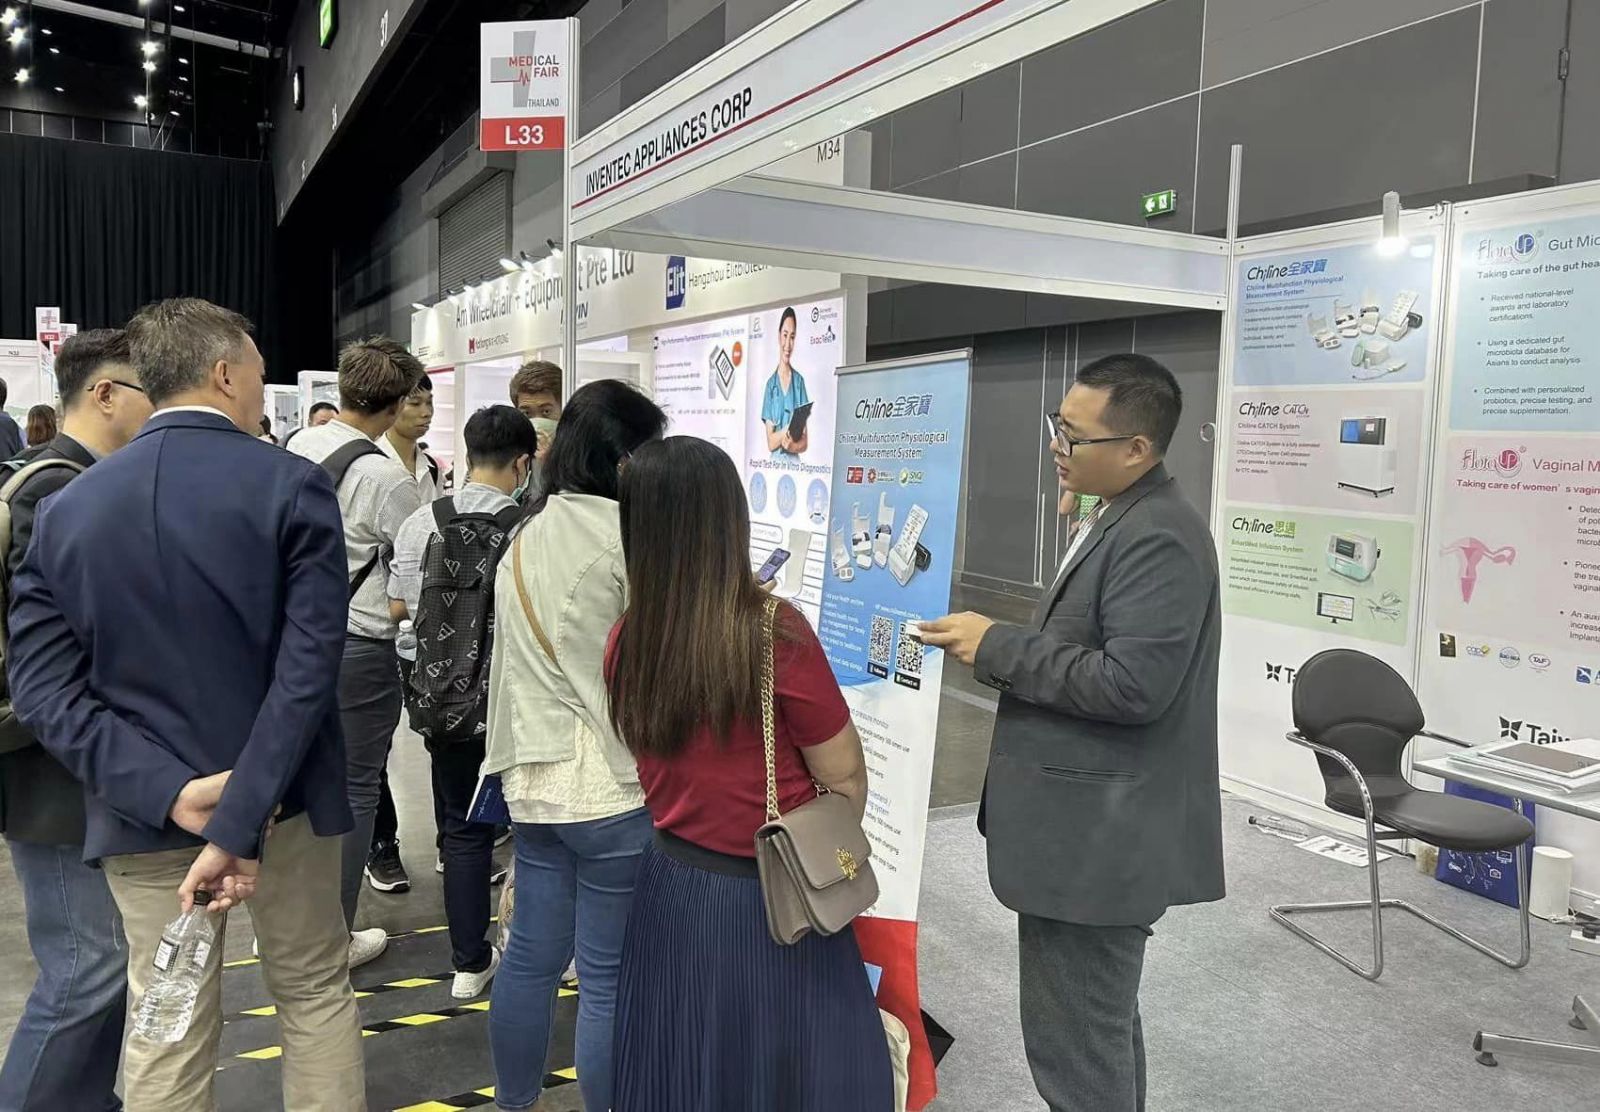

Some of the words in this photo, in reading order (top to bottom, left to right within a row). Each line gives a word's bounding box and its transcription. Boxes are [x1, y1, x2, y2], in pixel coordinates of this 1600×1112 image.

[508, 54, 560, 68] MEDICAL
[533, 66, 560, 78] FAIR
[528, 98, 560, 109] THAILAND
[505, 124, 544, 145] L33
[586, 152, 631, 197] INVENTEC
[633, 111, 707, 173] APPLIANCES
[710, 87, 752, 134] CORP
[817, 137, 841, 163] M34
[1548, 237, 1573, 251] Gut
[586, 254, 607, 289] Pte
[1477, 270, 1508, 279] Taking
[1509, 267, 1531, 277] care
[1532, 264, 1543, 274] of
[1545, 263, 1561, 273] the
[1562, 261, 1579, 273] gut
[667, 264, 685, 298] Elit
[688, 267, 724, 290] Hangzhou
[1266, 280, 1303, 289] Multifunction
[1303, 275, 1344, 287] Physiological
[1284, 288, 1305, 297] System
[1491, 292, 1524, 301] Received
[1525, 288, 1574, 299] national-level
[1490, 303, 1515, 312] awards
[1517, 301, 1531, 310] and
[1532, 299, 1569, 309] laboratory
[1488, 338, 1508, 347] Using
[1515, 337, 1551, 345] dedicated
[1552, 335, 1565, 345] gut
[1486, 347, 1523, 356] microbiota
[1524, 346, 1558, 355] database
[1486, 359, 1510, 367] Asians
[1511, 358, 1518, 366] to
[1519, 357, 1548, 365] conduct
[1549, 356, 1581, 366] analysis
[1484, 386, 1520, 394] Combined
[1521, 385, 1536, 393] with
[1537, 385, 1585, 396] personalized
[1520, 397, 1547, 406] precise
[1577, 395, 1592, 404] and
[1482, 407, 1508, 416] precise
[1278, 423, 1300, 431] System
[858, 432, 900, 443] Multifunction
[901, 430, 949, 446] Physiological
[855, 447, 897, 458] Measurement
[897, 447, 922, 459] System
[1533, 458, 1584, 473] Vaginal
[1457, 479, 1486, 490] Taking
[1487, 481, 1509, 490] care
[1510, 481, 1522, 490] of
[1578, 516, 1587, 524] of
[1282, 545, 1304, 553] System
[1574, 571, 1587, 581] the
[1571, 610, 1582, 618] An
